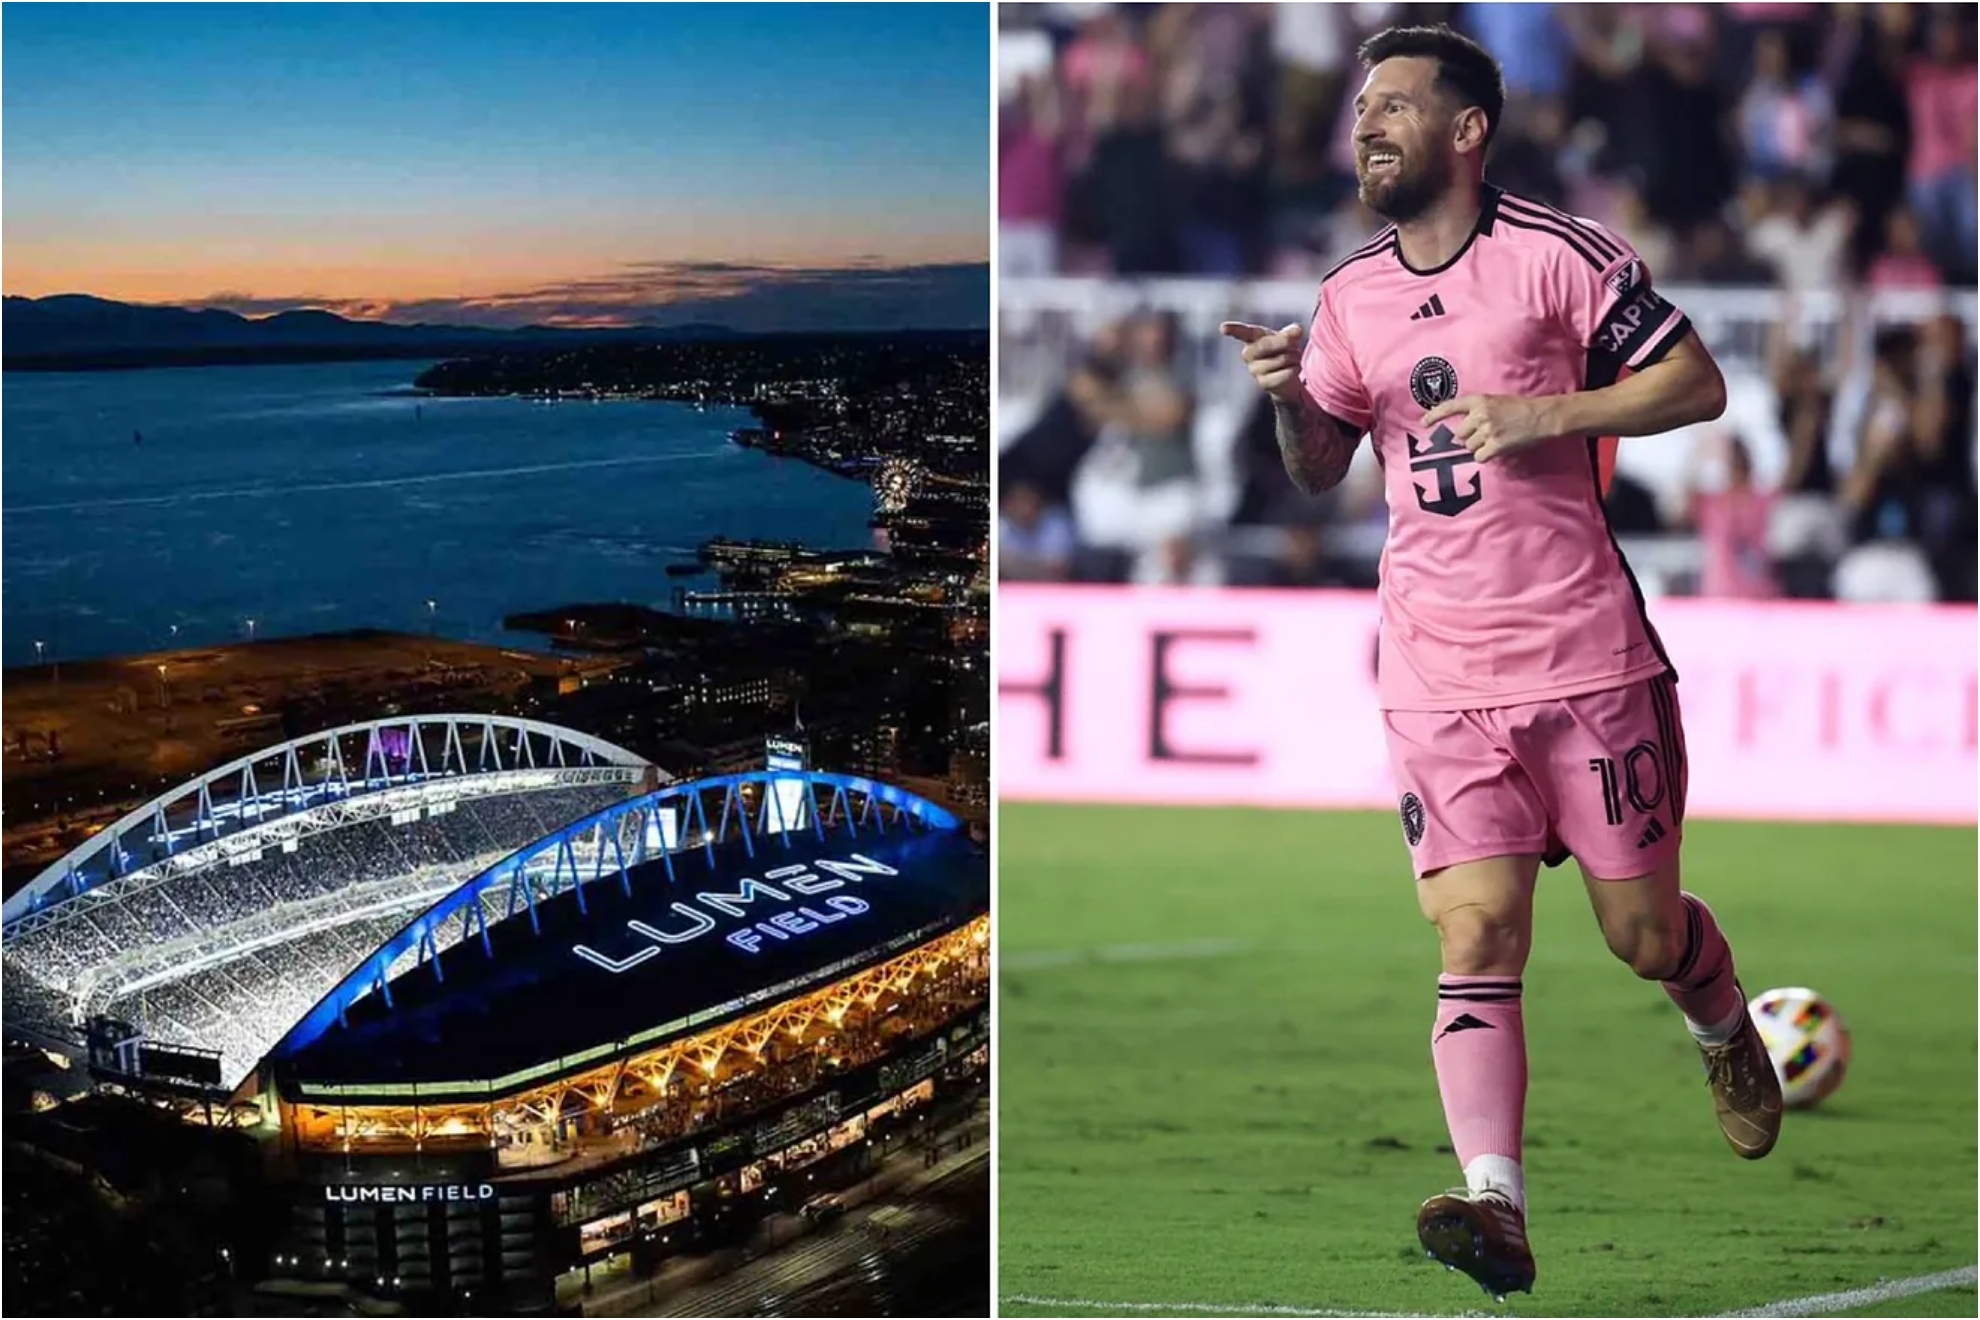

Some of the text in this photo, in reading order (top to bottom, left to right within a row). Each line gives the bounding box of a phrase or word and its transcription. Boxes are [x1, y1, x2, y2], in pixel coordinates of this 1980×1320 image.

[1609, 269, 1630, 289] MLS
[766, 739, 803, 752] LUMEN
[1589, 741, 1664, 826] 10
[572, 854, 899, 973] LUMEN
[726, 896, 870, 953] FIELD
[325, 1184, 494, 1202] LUMEN FIELD
